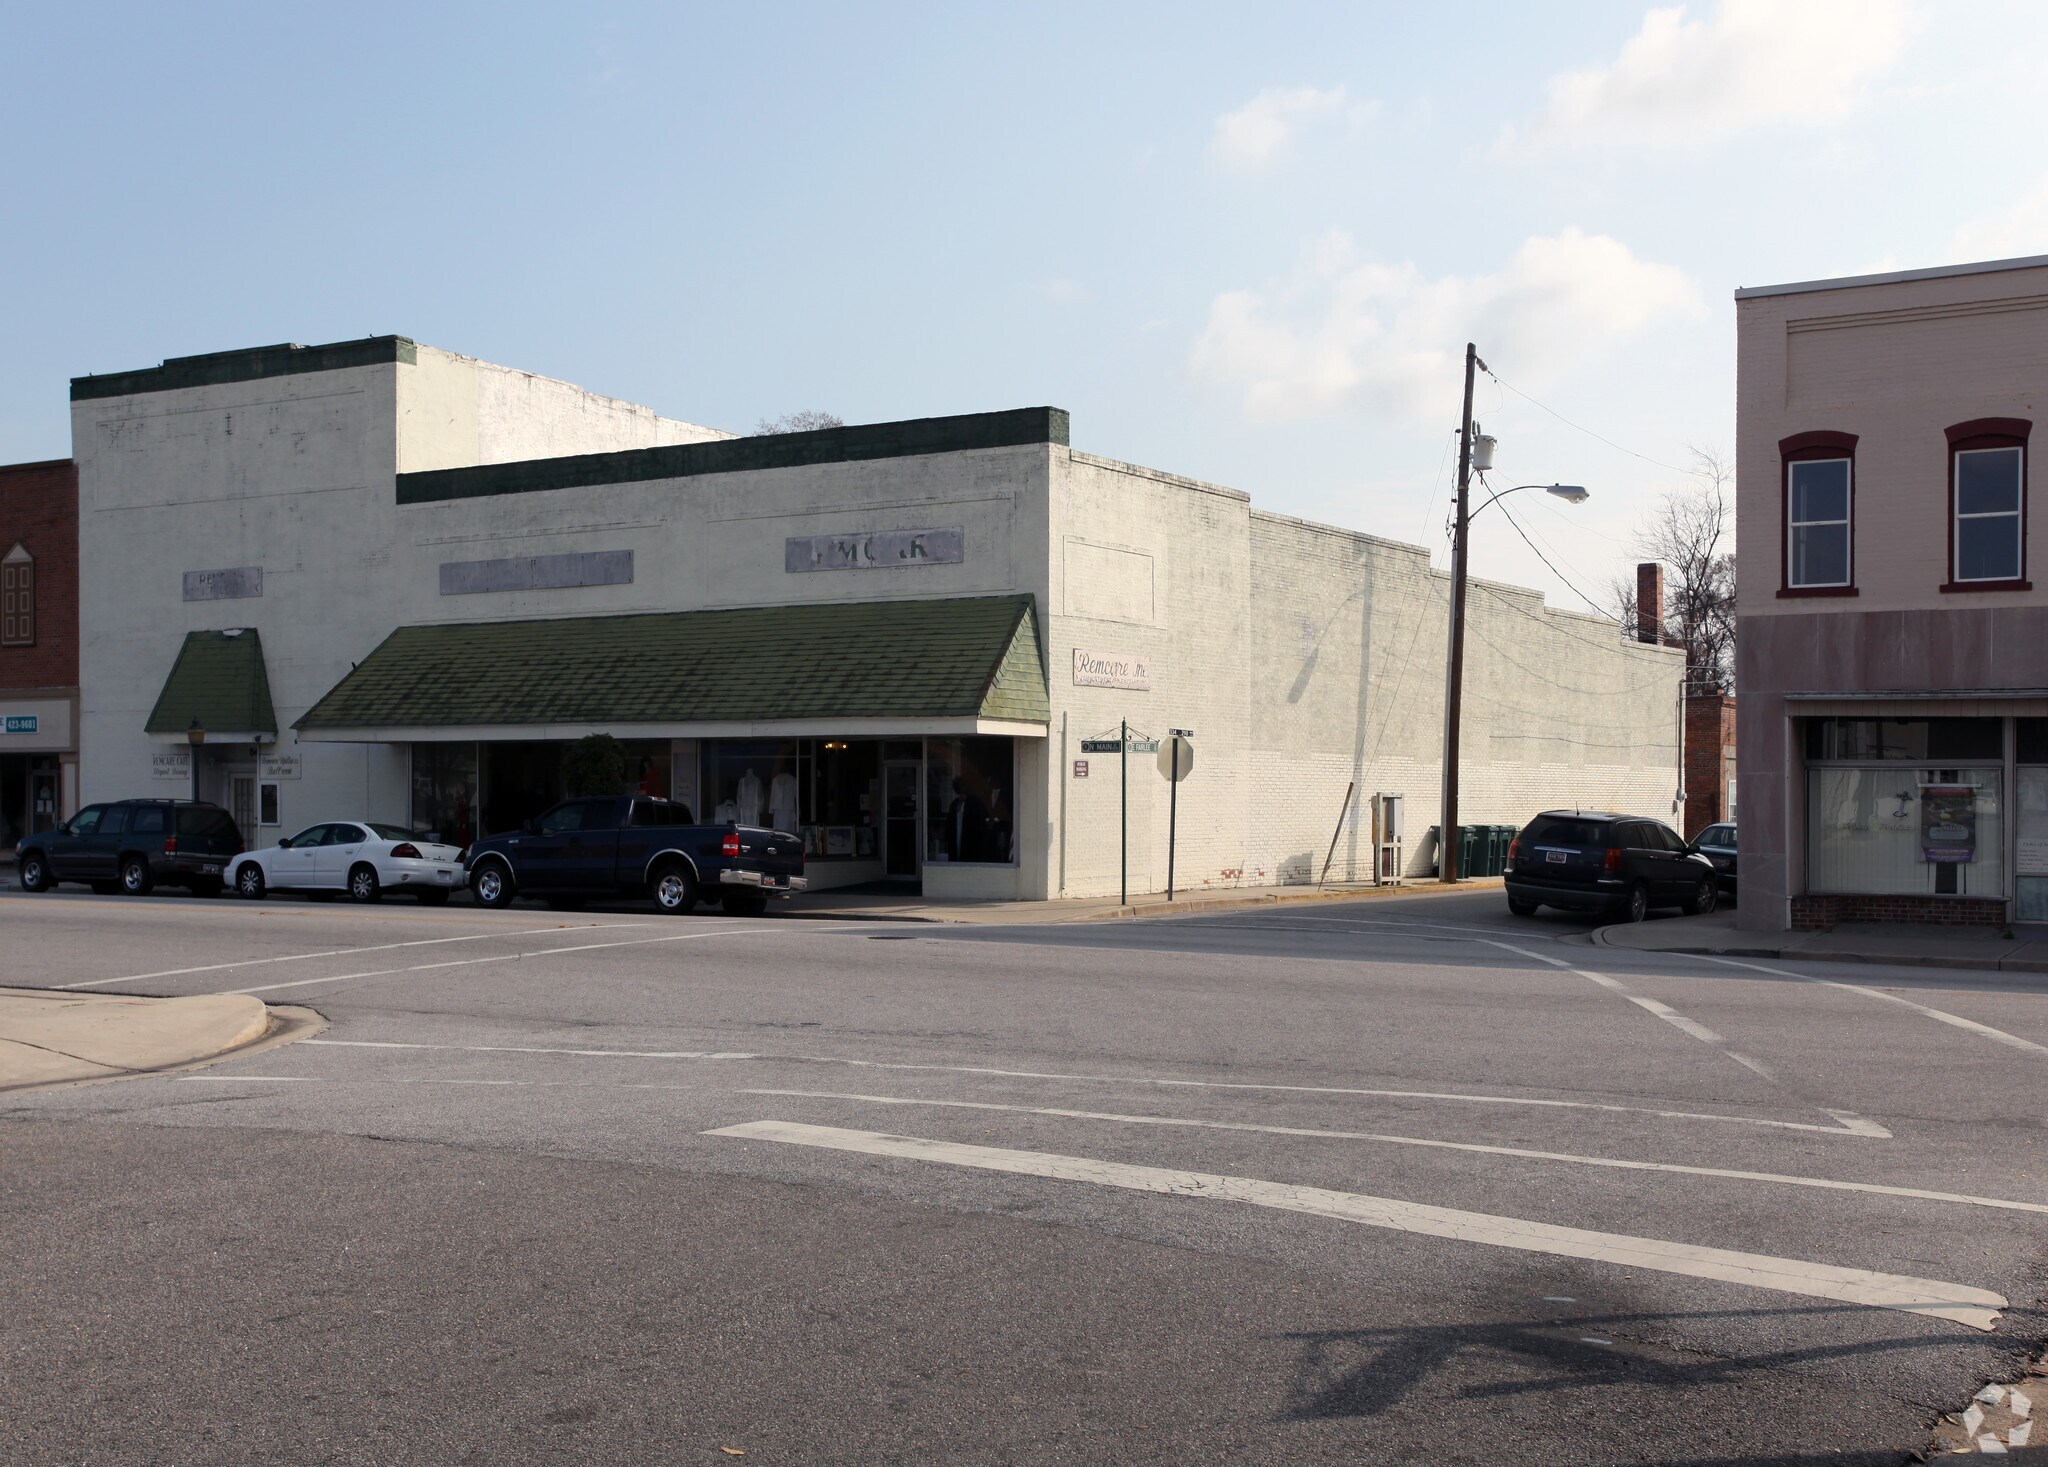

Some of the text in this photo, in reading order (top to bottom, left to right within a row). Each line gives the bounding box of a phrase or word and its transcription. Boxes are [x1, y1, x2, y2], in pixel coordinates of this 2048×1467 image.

[1078, 653, 1128, 677] Remcare
[8, 719, 36, 729] 423-9681
[1096, 743, 1112, 751] MAIN
[152, 756, 175, 766] REMCARE
